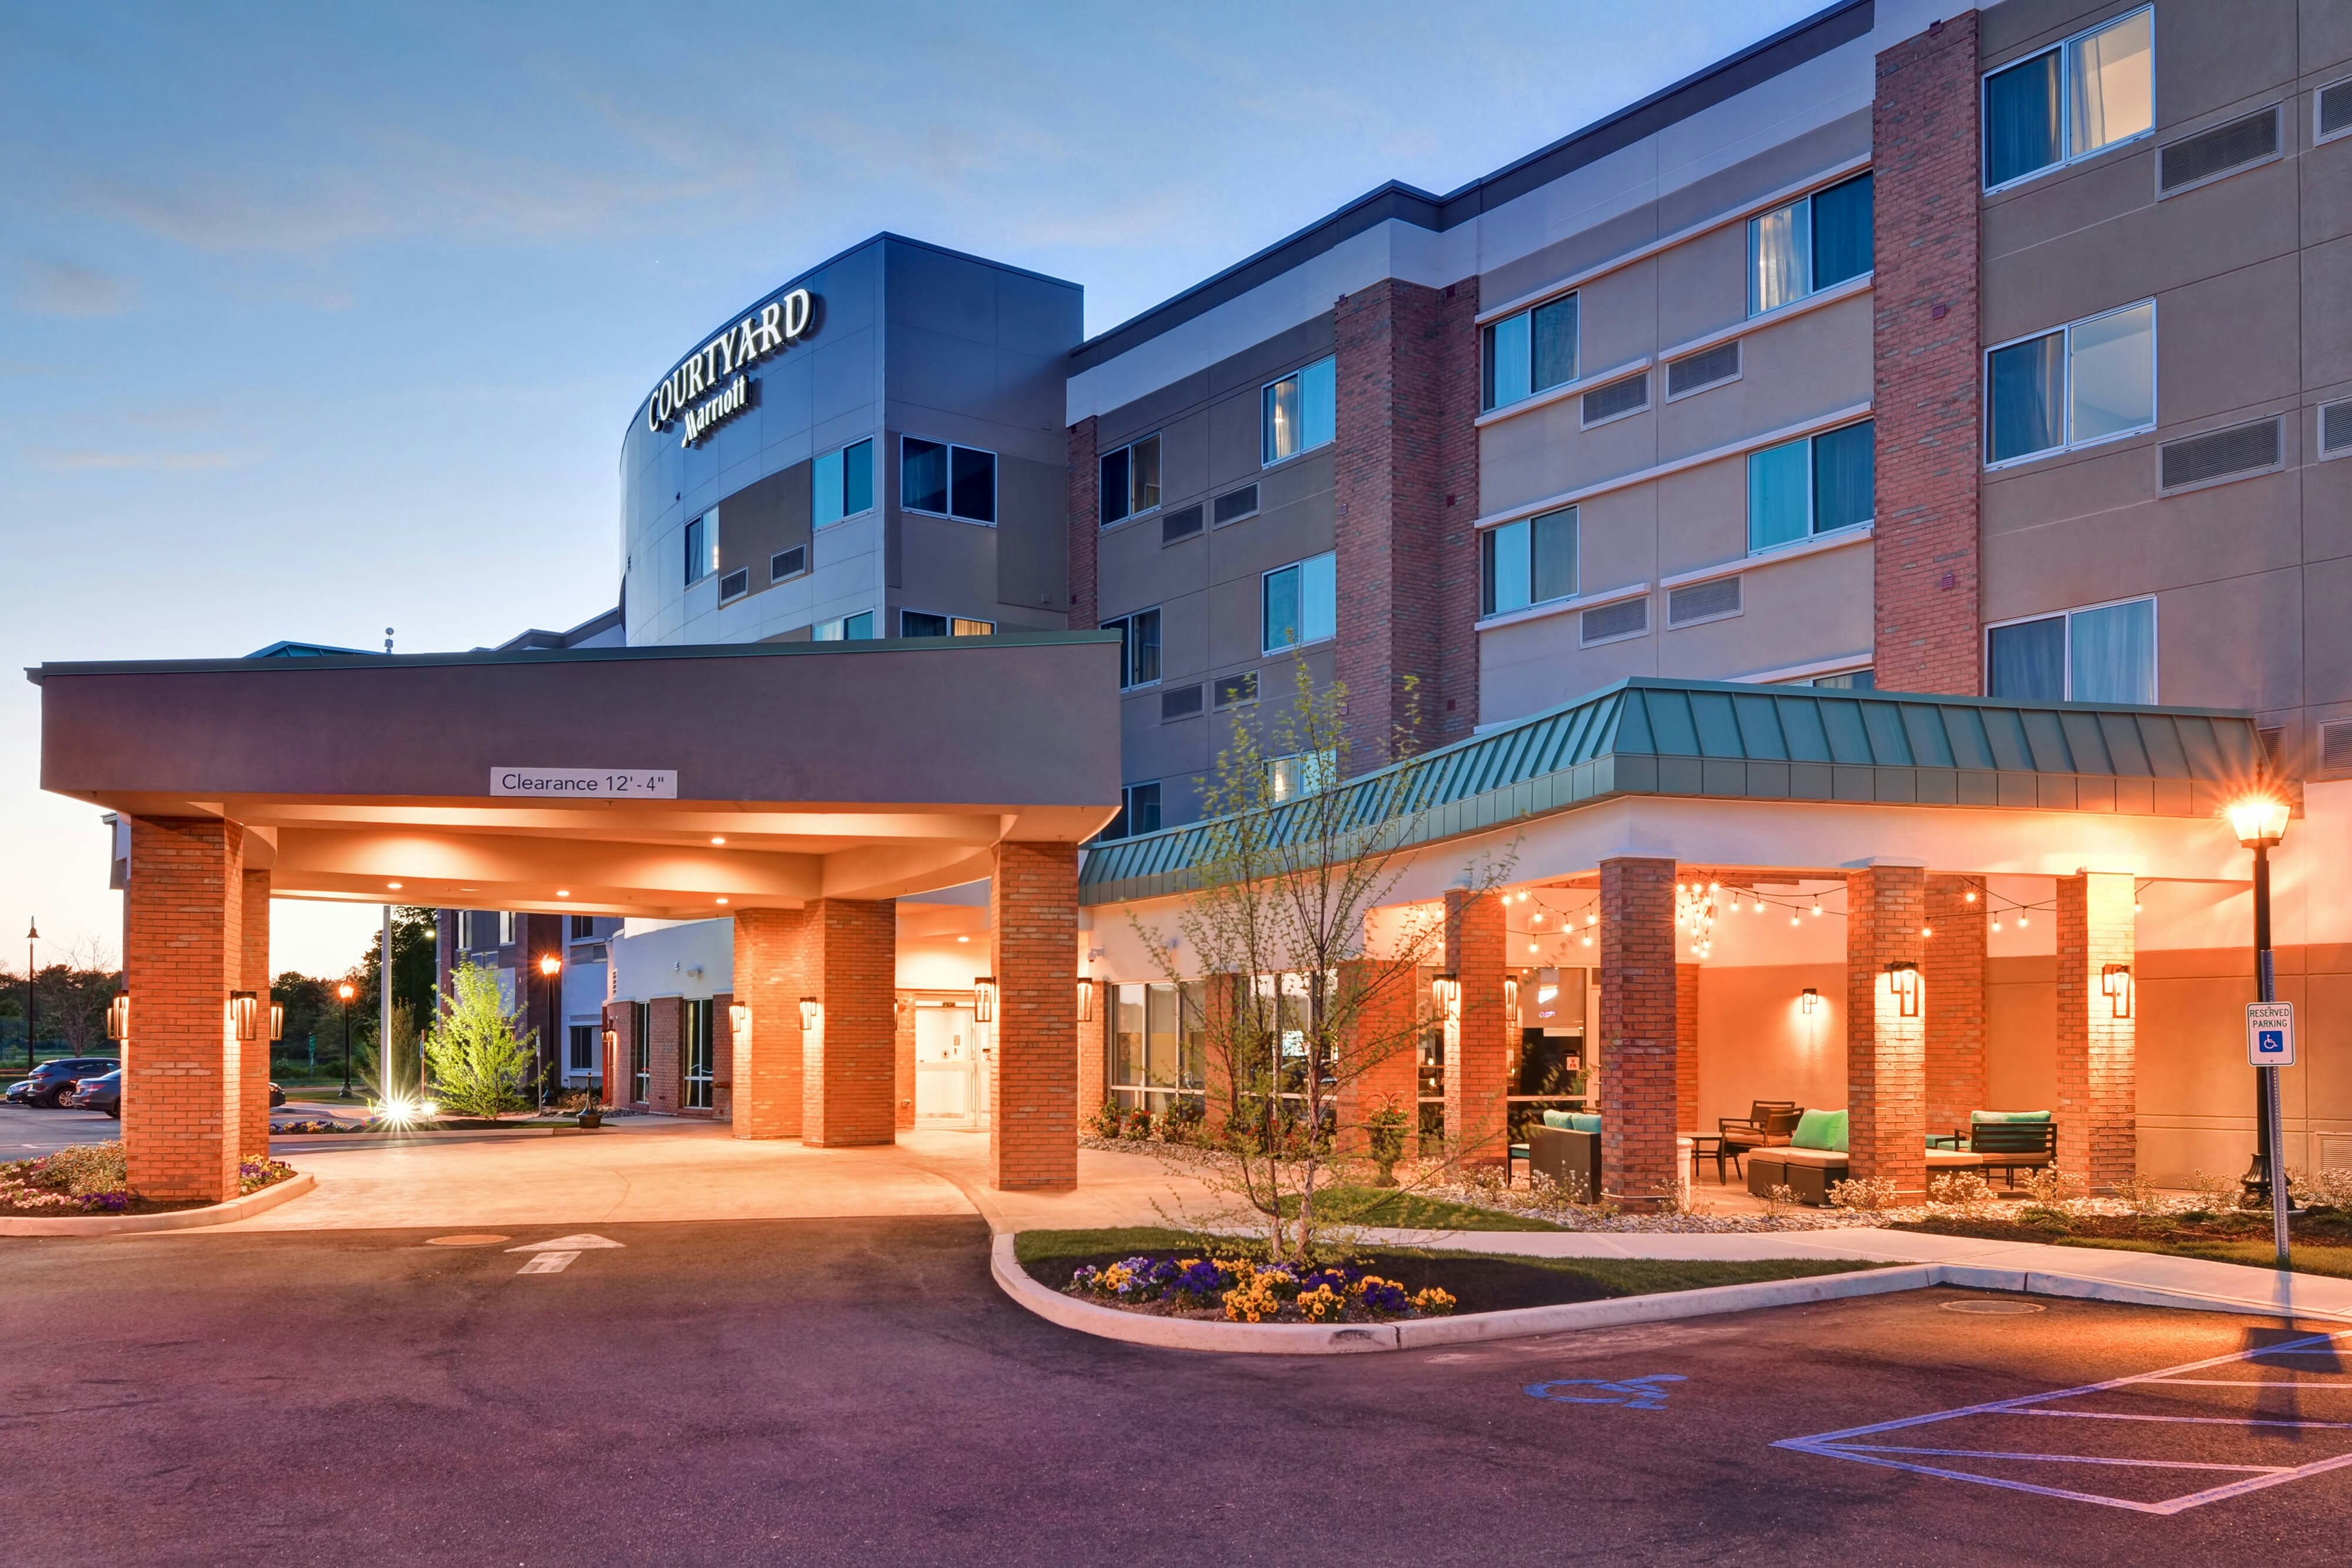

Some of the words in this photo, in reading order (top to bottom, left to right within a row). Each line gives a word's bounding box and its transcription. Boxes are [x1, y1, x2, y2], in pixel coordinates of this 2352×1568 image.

[649, 288, 813, 432] COURTYARD
[681, 375, 750, 448] Marriott
[502, 774, 598, 790] Clearance
[2250, 1008, 2289, 1017] RESERVED
[2253, 1019, 2287, 1028] PARKING
